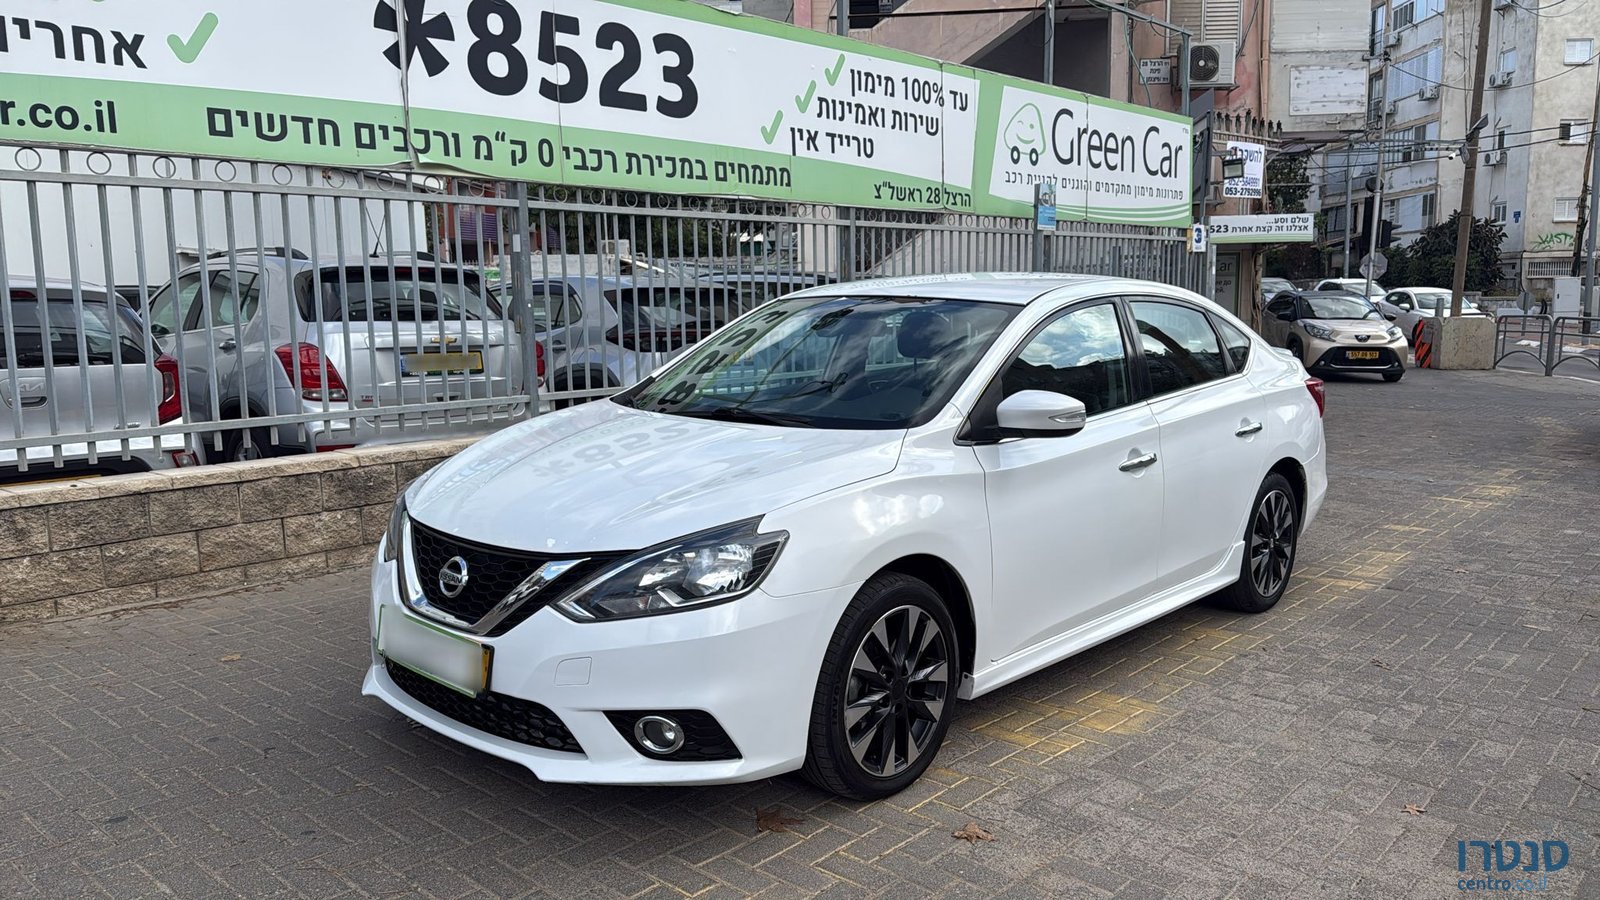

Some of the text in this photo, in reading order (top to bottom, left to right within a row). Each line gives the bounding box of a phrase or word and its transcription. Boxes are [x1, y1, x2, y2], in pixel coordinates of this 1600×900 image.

[849, 68, 969, 112] עד 100% מימון
[816, 96, 939, 136] שירות ואמינות
[206, 106, 341, 148] חדשים
[354, 121, 462, 158] ורכבים
[789, 126, 875, 159] טרייד אין
[1051, 108, 1183, 179] Green Car
[562, 144, 618, 172] רכבי
[625, 151, 708, 181] במכירת
[714, 159, 792, 187] מתמחים
[1004, 170, 1022, 184] רכב
[925, 186, 942, 204] 28
[943, 187, 972, 207] הרצל
[1095, 180, 1132, 197] מתקדמים
[1133, 185, 1154, 199] מימון
[1156, 187, 1184, 201] פתרונות
[1231, 225, 1253, 233] אחרת
[1286, 223, 1309, 232] אצלנו
[1291, 215, 1309, 224] שלם
[1255, 225, 1273, 234] קצת
[1216, 261, 1233, 272] ar
